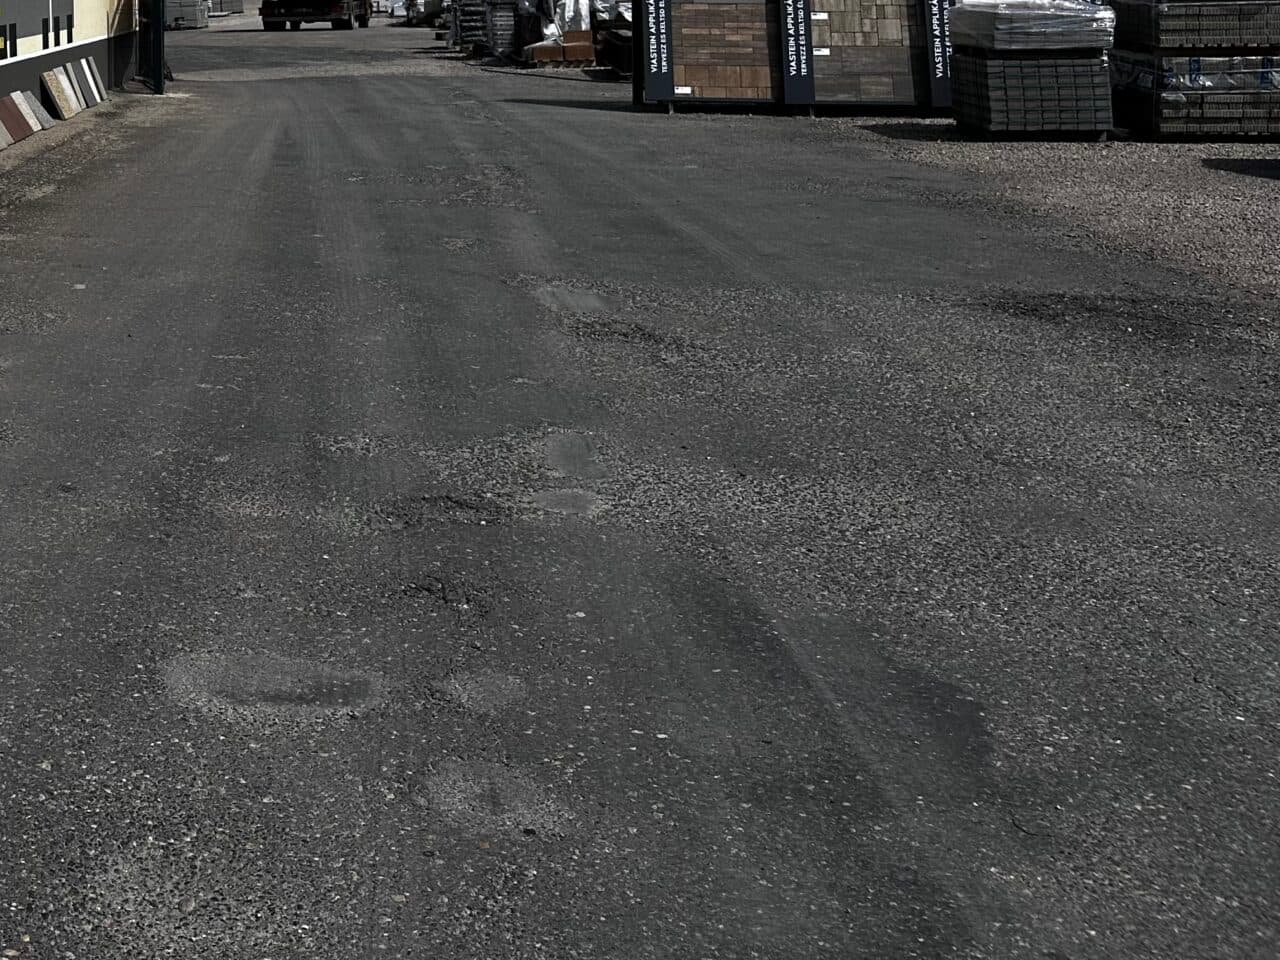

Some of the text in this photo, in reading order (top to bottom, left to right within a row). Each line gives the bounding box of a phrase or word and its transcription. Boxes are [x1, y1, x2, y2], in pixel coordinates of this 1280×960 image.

[649, 35, 658, 73] VIASTEIN
[788, 36, 797, 76] VIASTEIN
[933, 38, 944, 78] VIASTEIN
